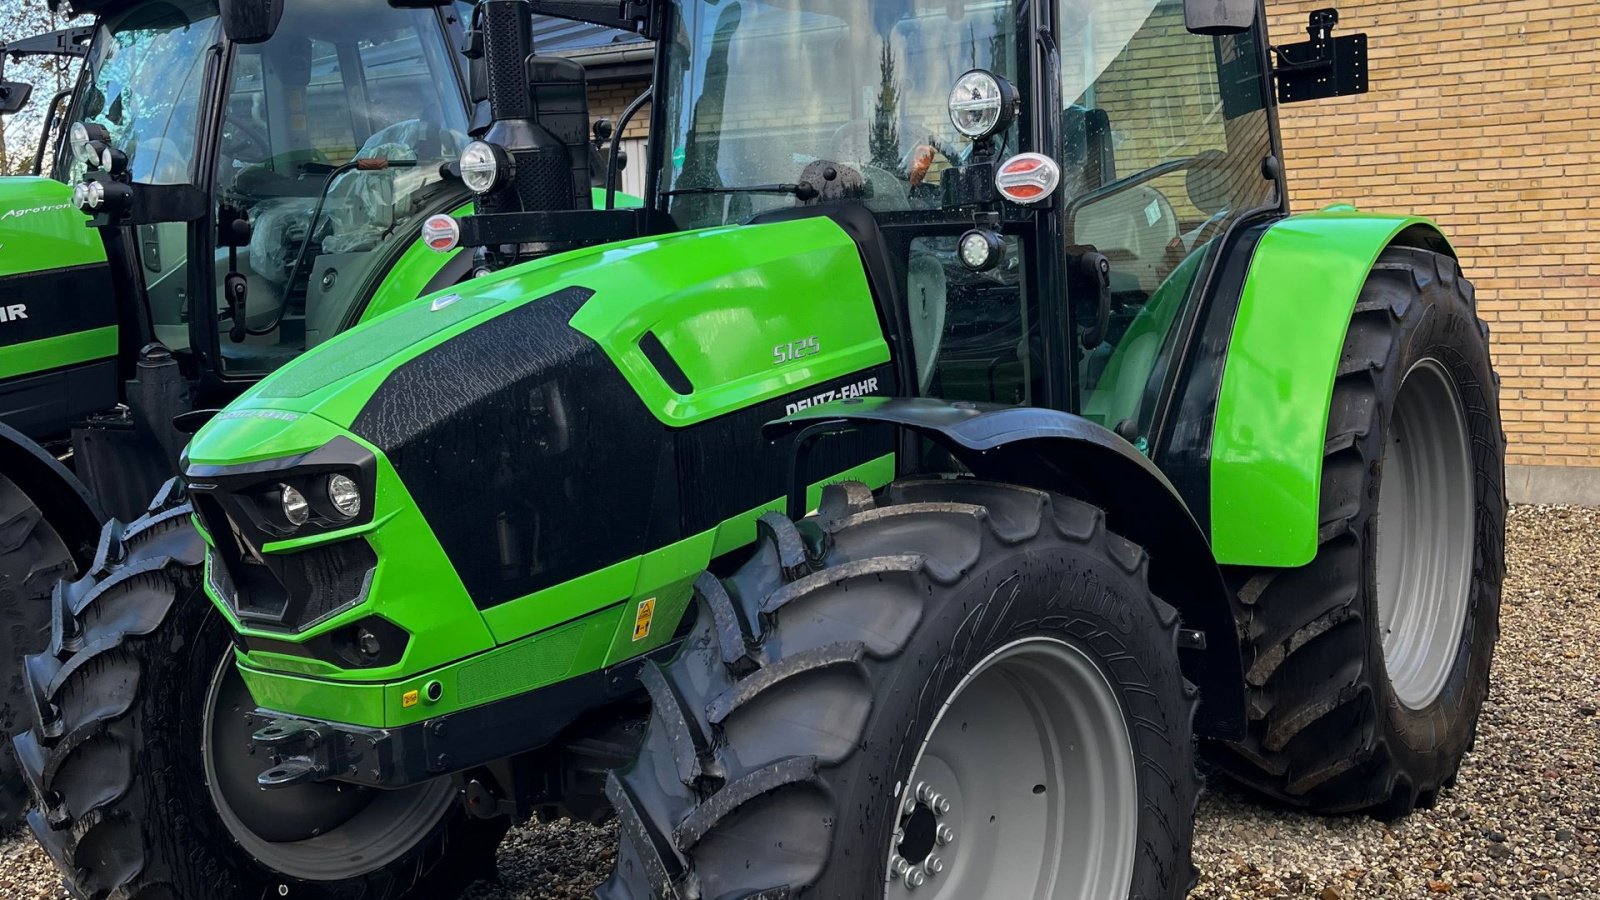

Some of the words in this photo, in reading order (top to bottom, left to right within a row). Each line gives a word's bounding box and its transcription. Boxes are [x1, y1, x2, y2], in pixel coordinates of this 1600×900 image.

[1, 203, 71, 220] Agrotron
[773, 336, 820, 365] 5125
[786, 377, 879, 416] DEUTZ-FAHR
